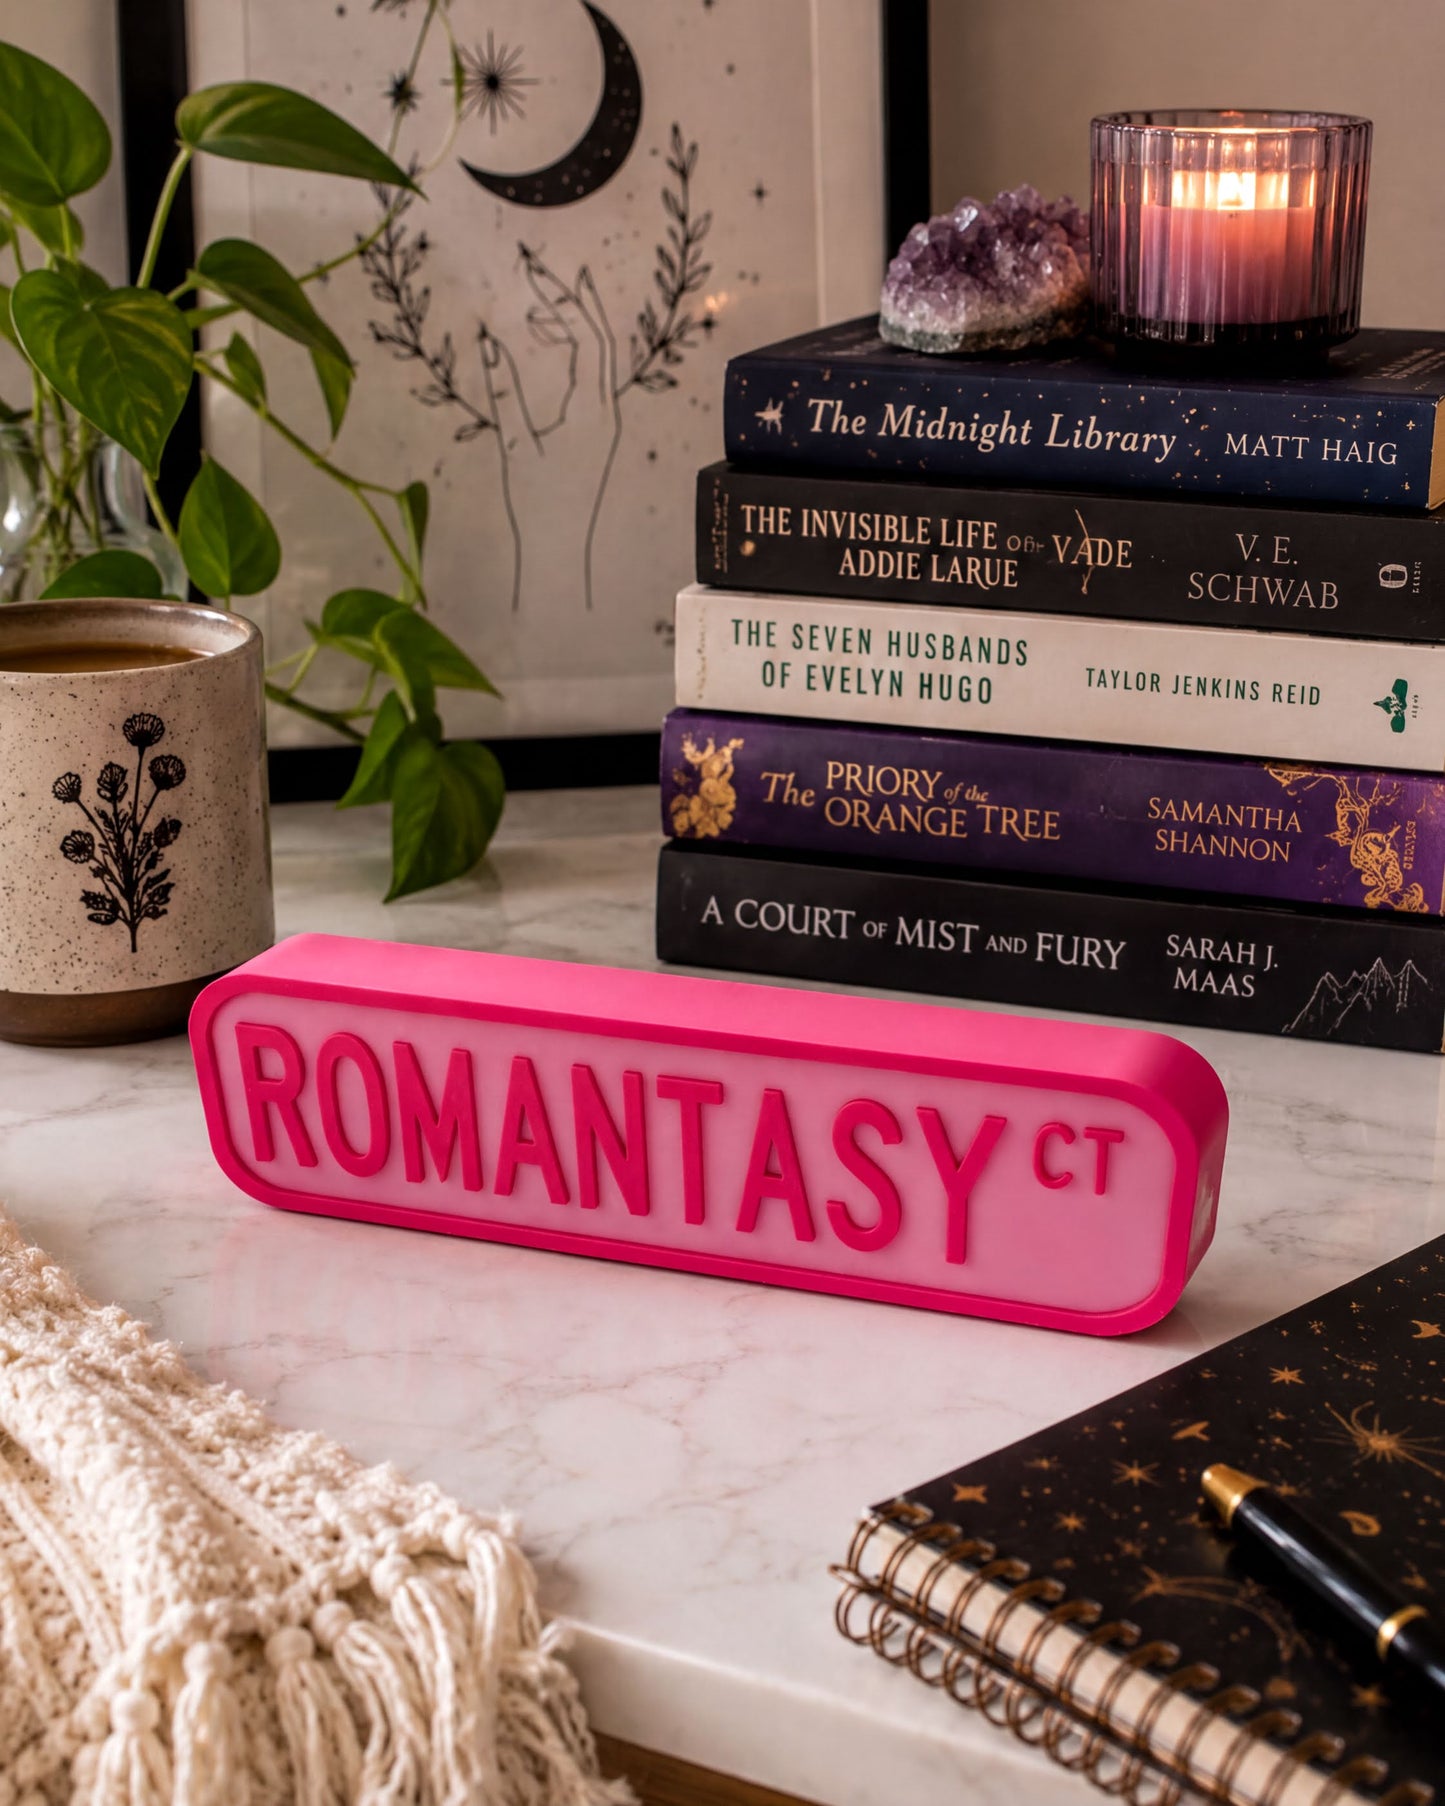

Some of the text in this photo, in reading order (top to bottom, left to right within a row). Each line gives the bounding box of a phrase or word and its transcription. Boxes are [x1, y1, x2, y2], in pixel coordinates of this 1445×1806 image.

[809, 399, 1176, 463] The Midnight Library
[1225, 433, 1396, 464] MATT HAIG
[741, 505, 791, 535] THE
[802, 509, 930, 544] INVISIBLE
[941, 519, 997, 549] LIFE
[840, 549, 1017, 589] ADDIE LARUE
[1236, 534, 1297, 564] V. E.
[1189, 572, 1338, 609] SCHWAB
[732, 619, 1027, 666] THE SEVEN HUSBANDS
[763, 661, 991, 704] OF EVELYN HUGO
[1086, 668, 1320, 705] TAYLOR JENKINS REID
[761, 760, 988, 806] The PRIORY of the
[824, 797, 1059, 841] ORANGE TREE
[1148, 797, 1303, 833] SAMANTHA
[1155, 829, 1291, 863] SHANNON
[702, 896, 1126, 969] A COURT OF MIST AND FURY
[1166, 934, 1279, 972] SARAH J.
[1174, 967, 1254, 997] MAAS
[234, 1021, 1126, 1264] ROMANTASY CT
